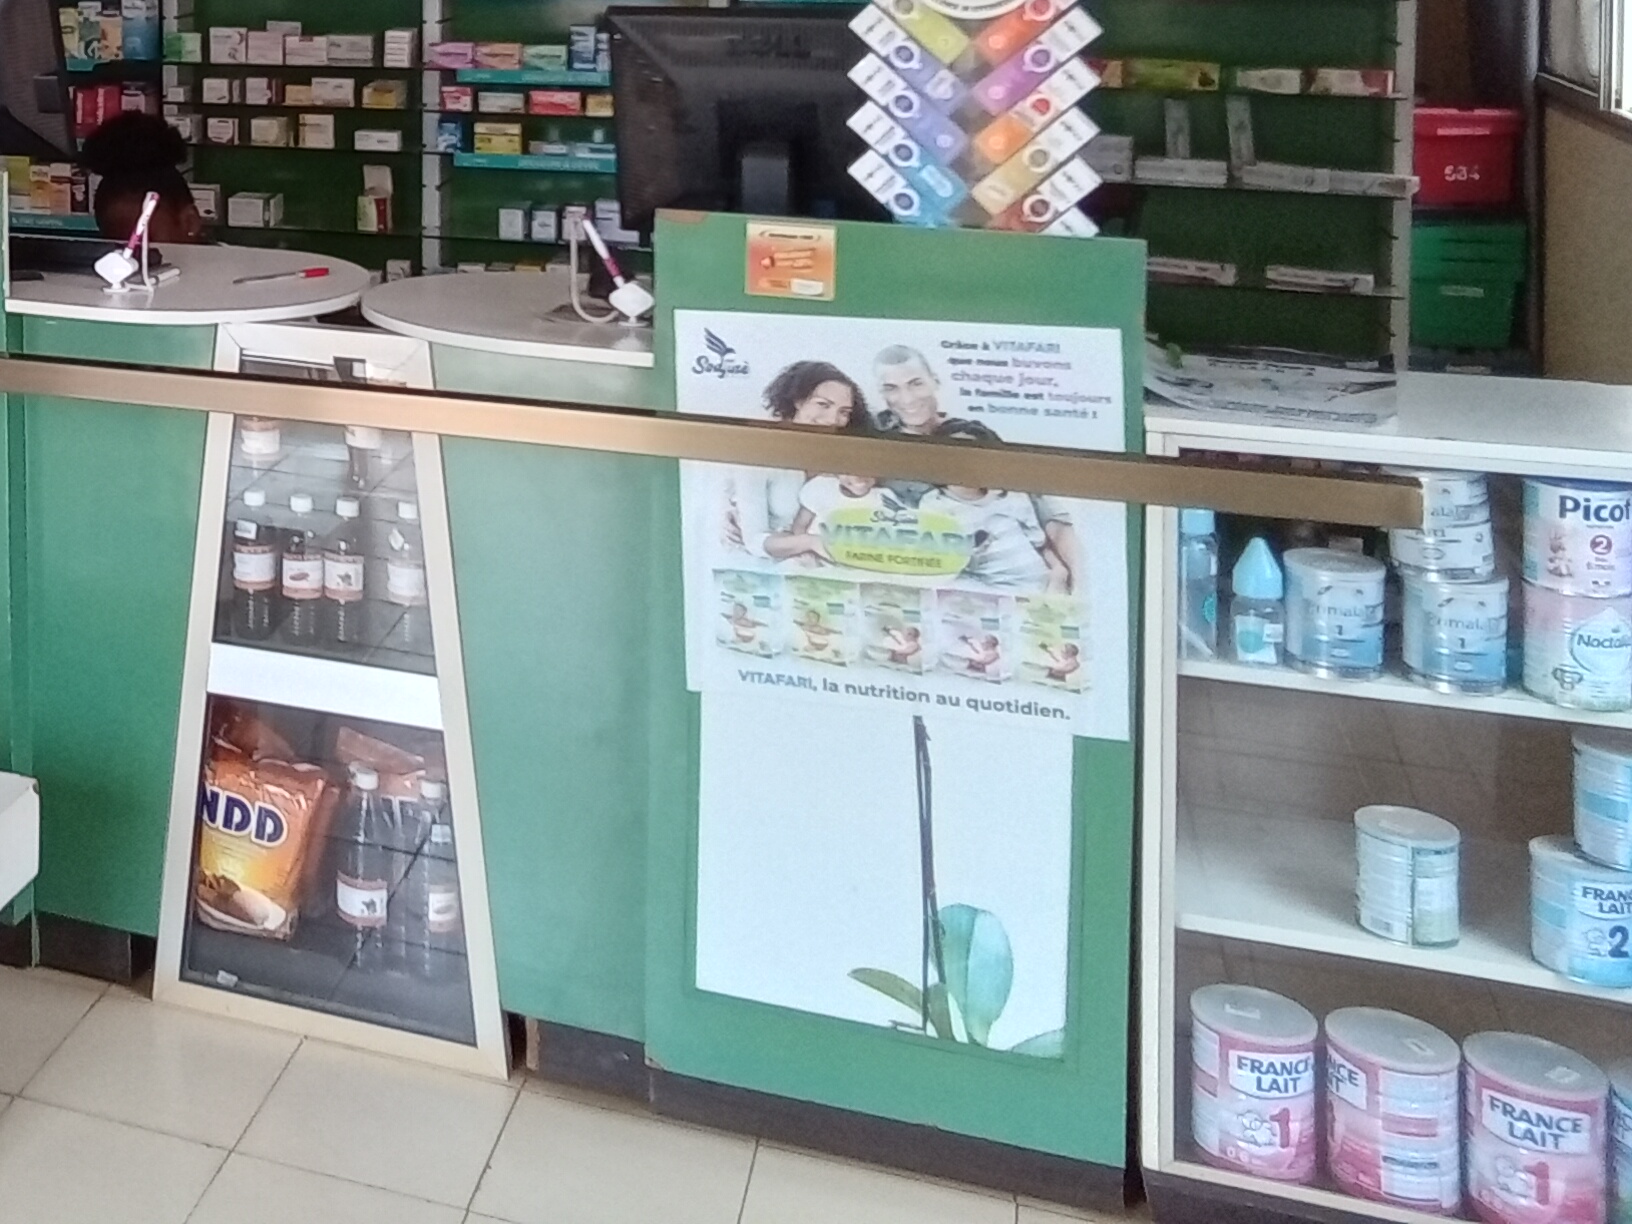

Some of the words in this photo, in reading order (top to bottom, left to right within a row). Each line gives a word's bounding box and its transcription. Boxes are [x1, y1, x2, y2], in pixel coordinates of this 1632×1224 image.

[950, 370, 1015, 385] chaque
[1593, 537, 1609, 552] 2
[737, 668, 818, 692] VITAFARI,
[822, 677, 839, 693] la
[845, 682, 931, 704] nutrition
[935, 693, 961, 708] au
[965, 696, 1072, 721] quotidien.
[1598, 902, 1632, 915] LAIT
[1608, 925, 1630, 959] 2
[1256, 1076, 1302, 1094] LAIT
[1269, 1107, 1291, 1149] 1
[1488, 1094, 1584, 1134] FRANCE
[1508, 1121, 1566, 1150] LAIT
[1523, 1161, 1550, 1206] 1
